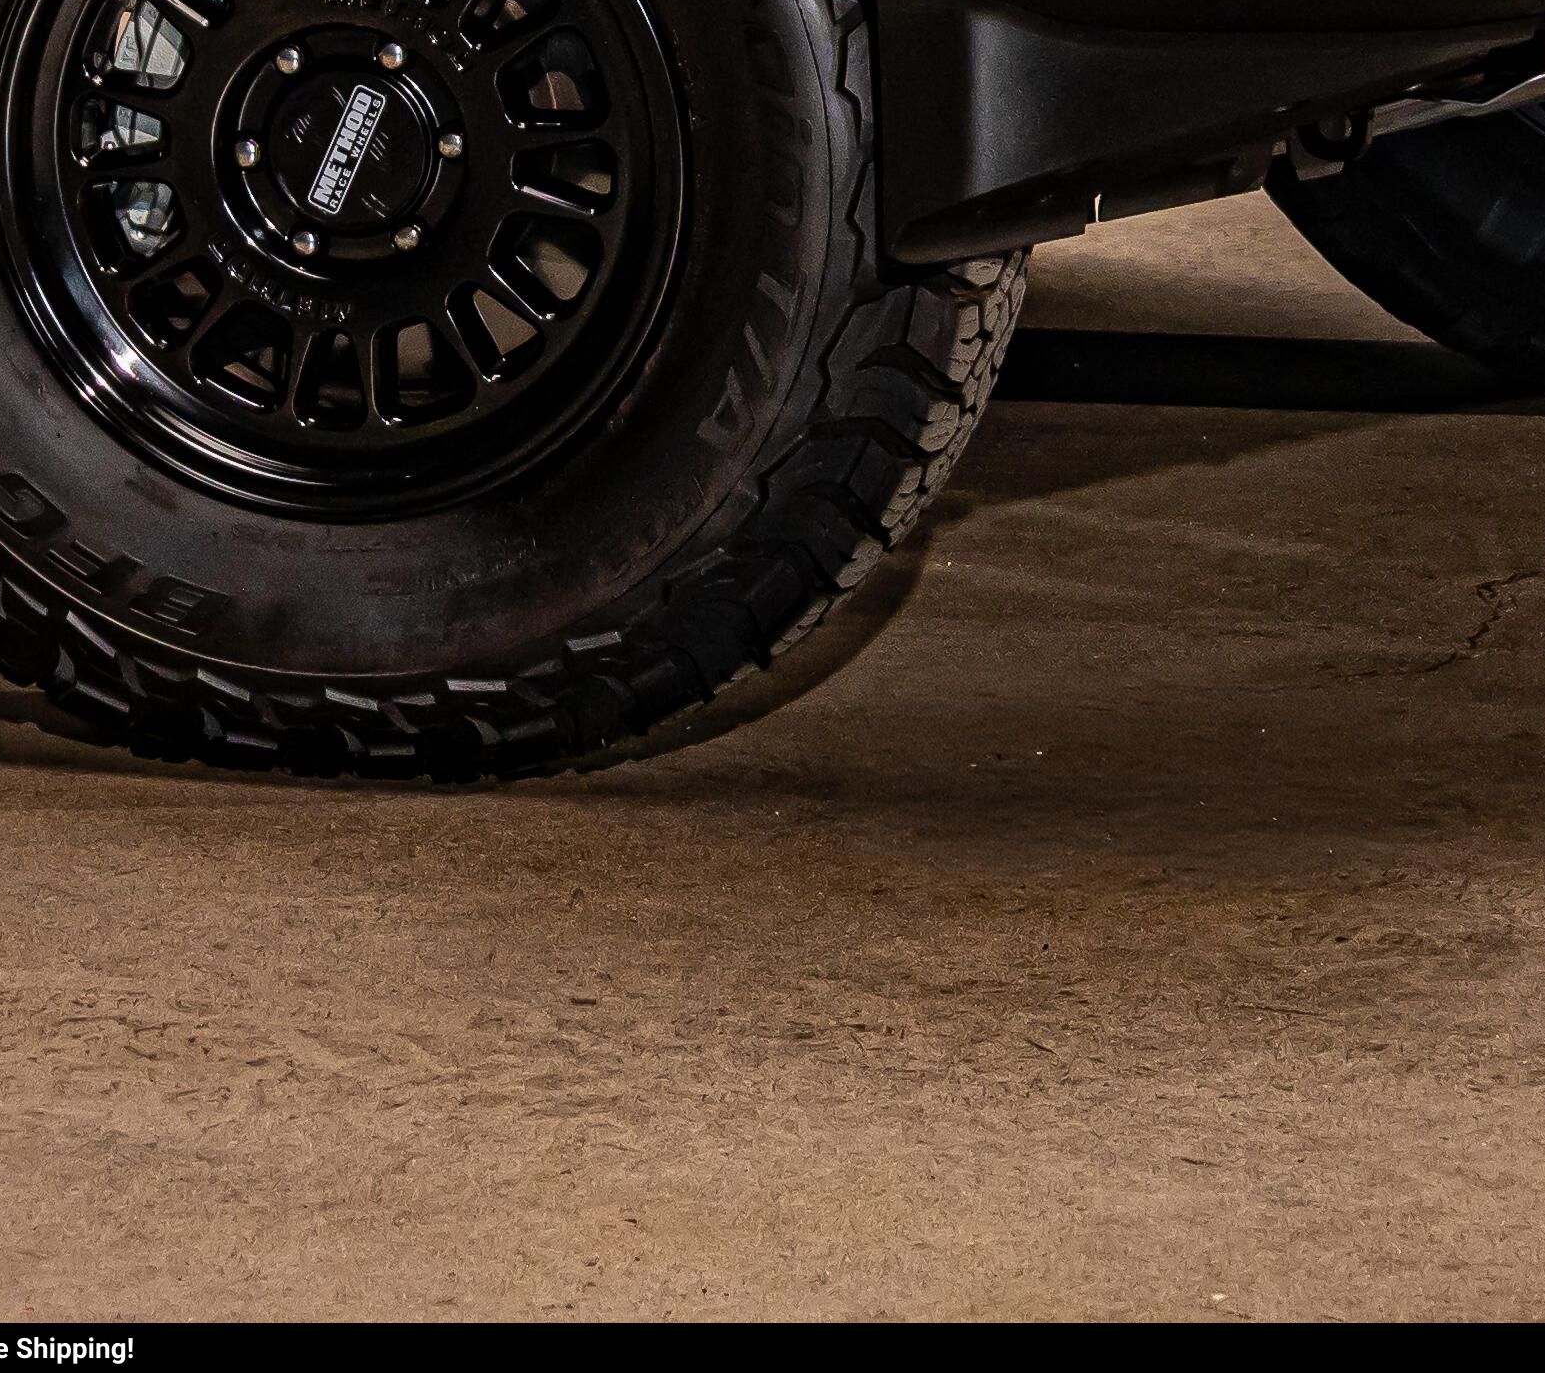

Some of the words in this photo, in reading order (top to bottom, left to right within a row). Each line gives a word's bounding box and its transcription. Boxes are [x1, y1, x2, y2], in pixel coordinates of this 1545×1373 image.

[312, 91, 373, 205] METHOD
[329, 168, 352, 209] RACE
[350, 98, 382, 158] WHEELS
[696, 267, 807, 448] T/A
